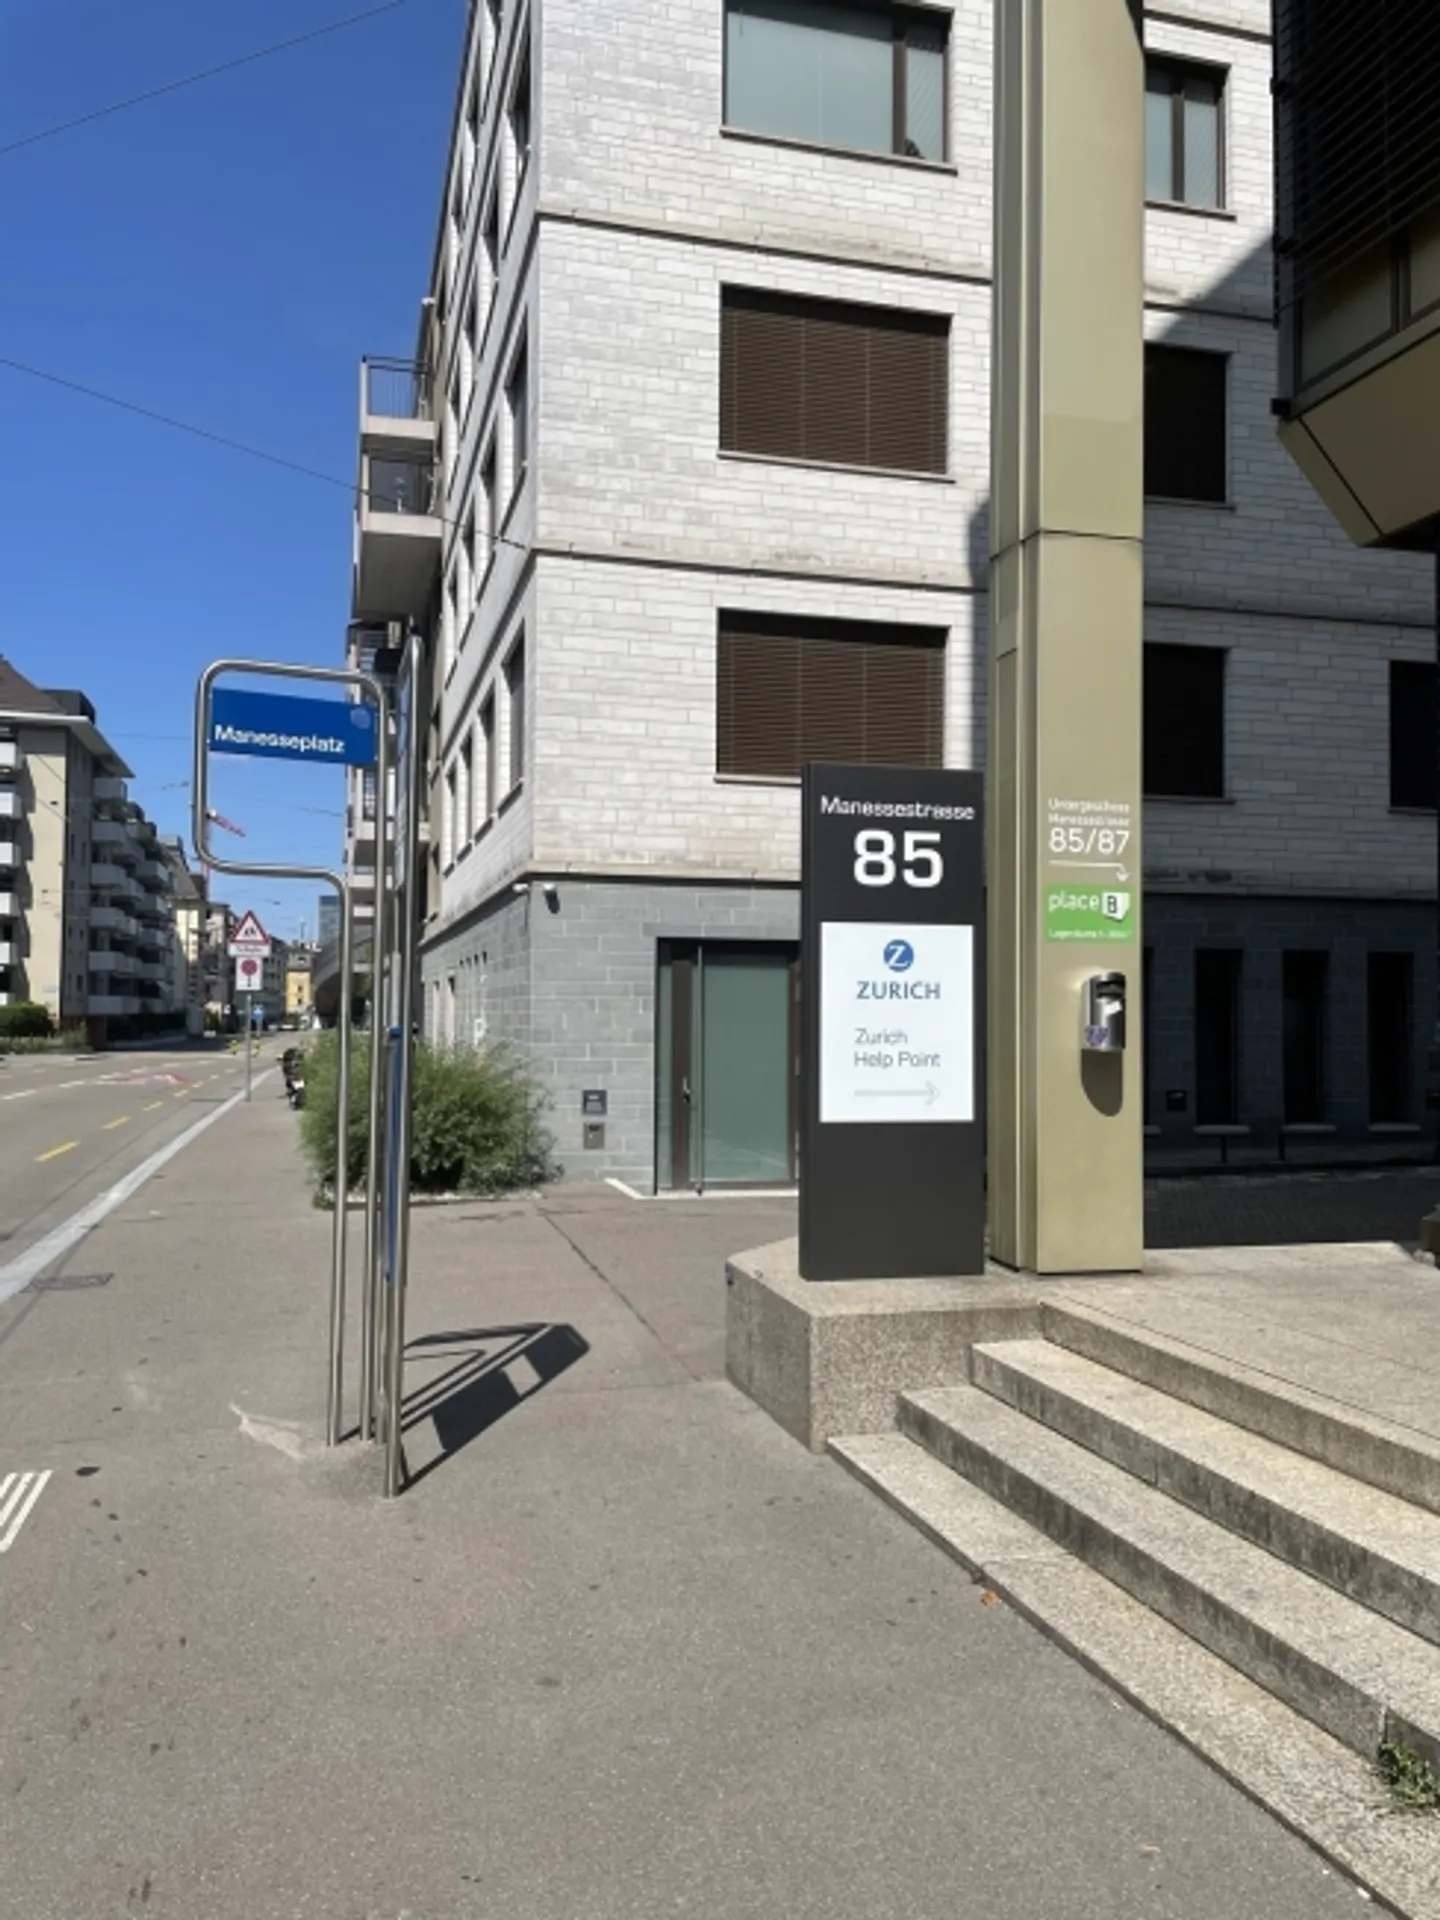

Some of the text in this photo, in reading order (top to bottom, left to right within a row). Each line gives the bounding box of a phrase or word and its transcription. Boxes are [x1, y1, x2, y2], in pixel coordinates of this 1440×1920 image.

[213, 724, 346, 753] Manesseplatz
[820, 796, 975, 820] Manessestrasse
[1048, 827, 1131, 855] 85/87
[853, 829, 944, 888] 85
[1048, 890, 1100, 912] place
[856, 981, 941, 1000] ZURICH
[854, 1028, 908, 1046] Zurich
[853, 1051, 941, 1069] Help Point
